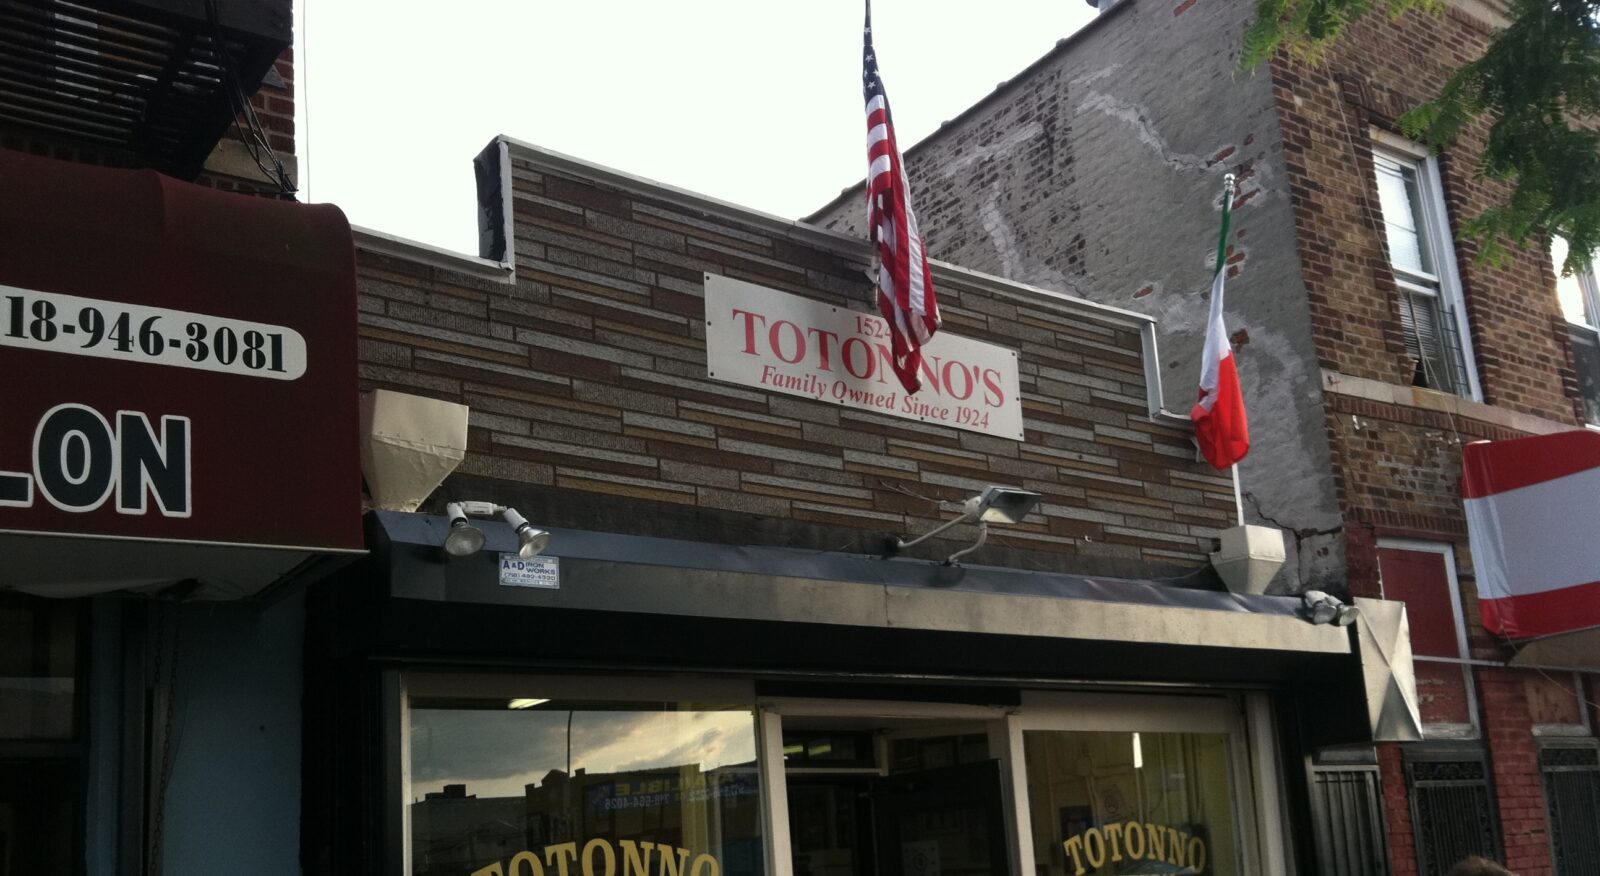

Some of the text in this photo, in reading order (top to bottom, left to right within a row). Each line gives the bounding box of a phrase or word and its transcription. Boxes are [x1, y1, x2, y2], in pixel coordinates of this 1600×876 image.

[732, 308, 1005, 408] TOTONNO'S
[760, 365, 990, 429] Family Owned Since 1924
[470, 838, 720, 876] TONN
[1064, 821, 1206, 876] TOTONNO
